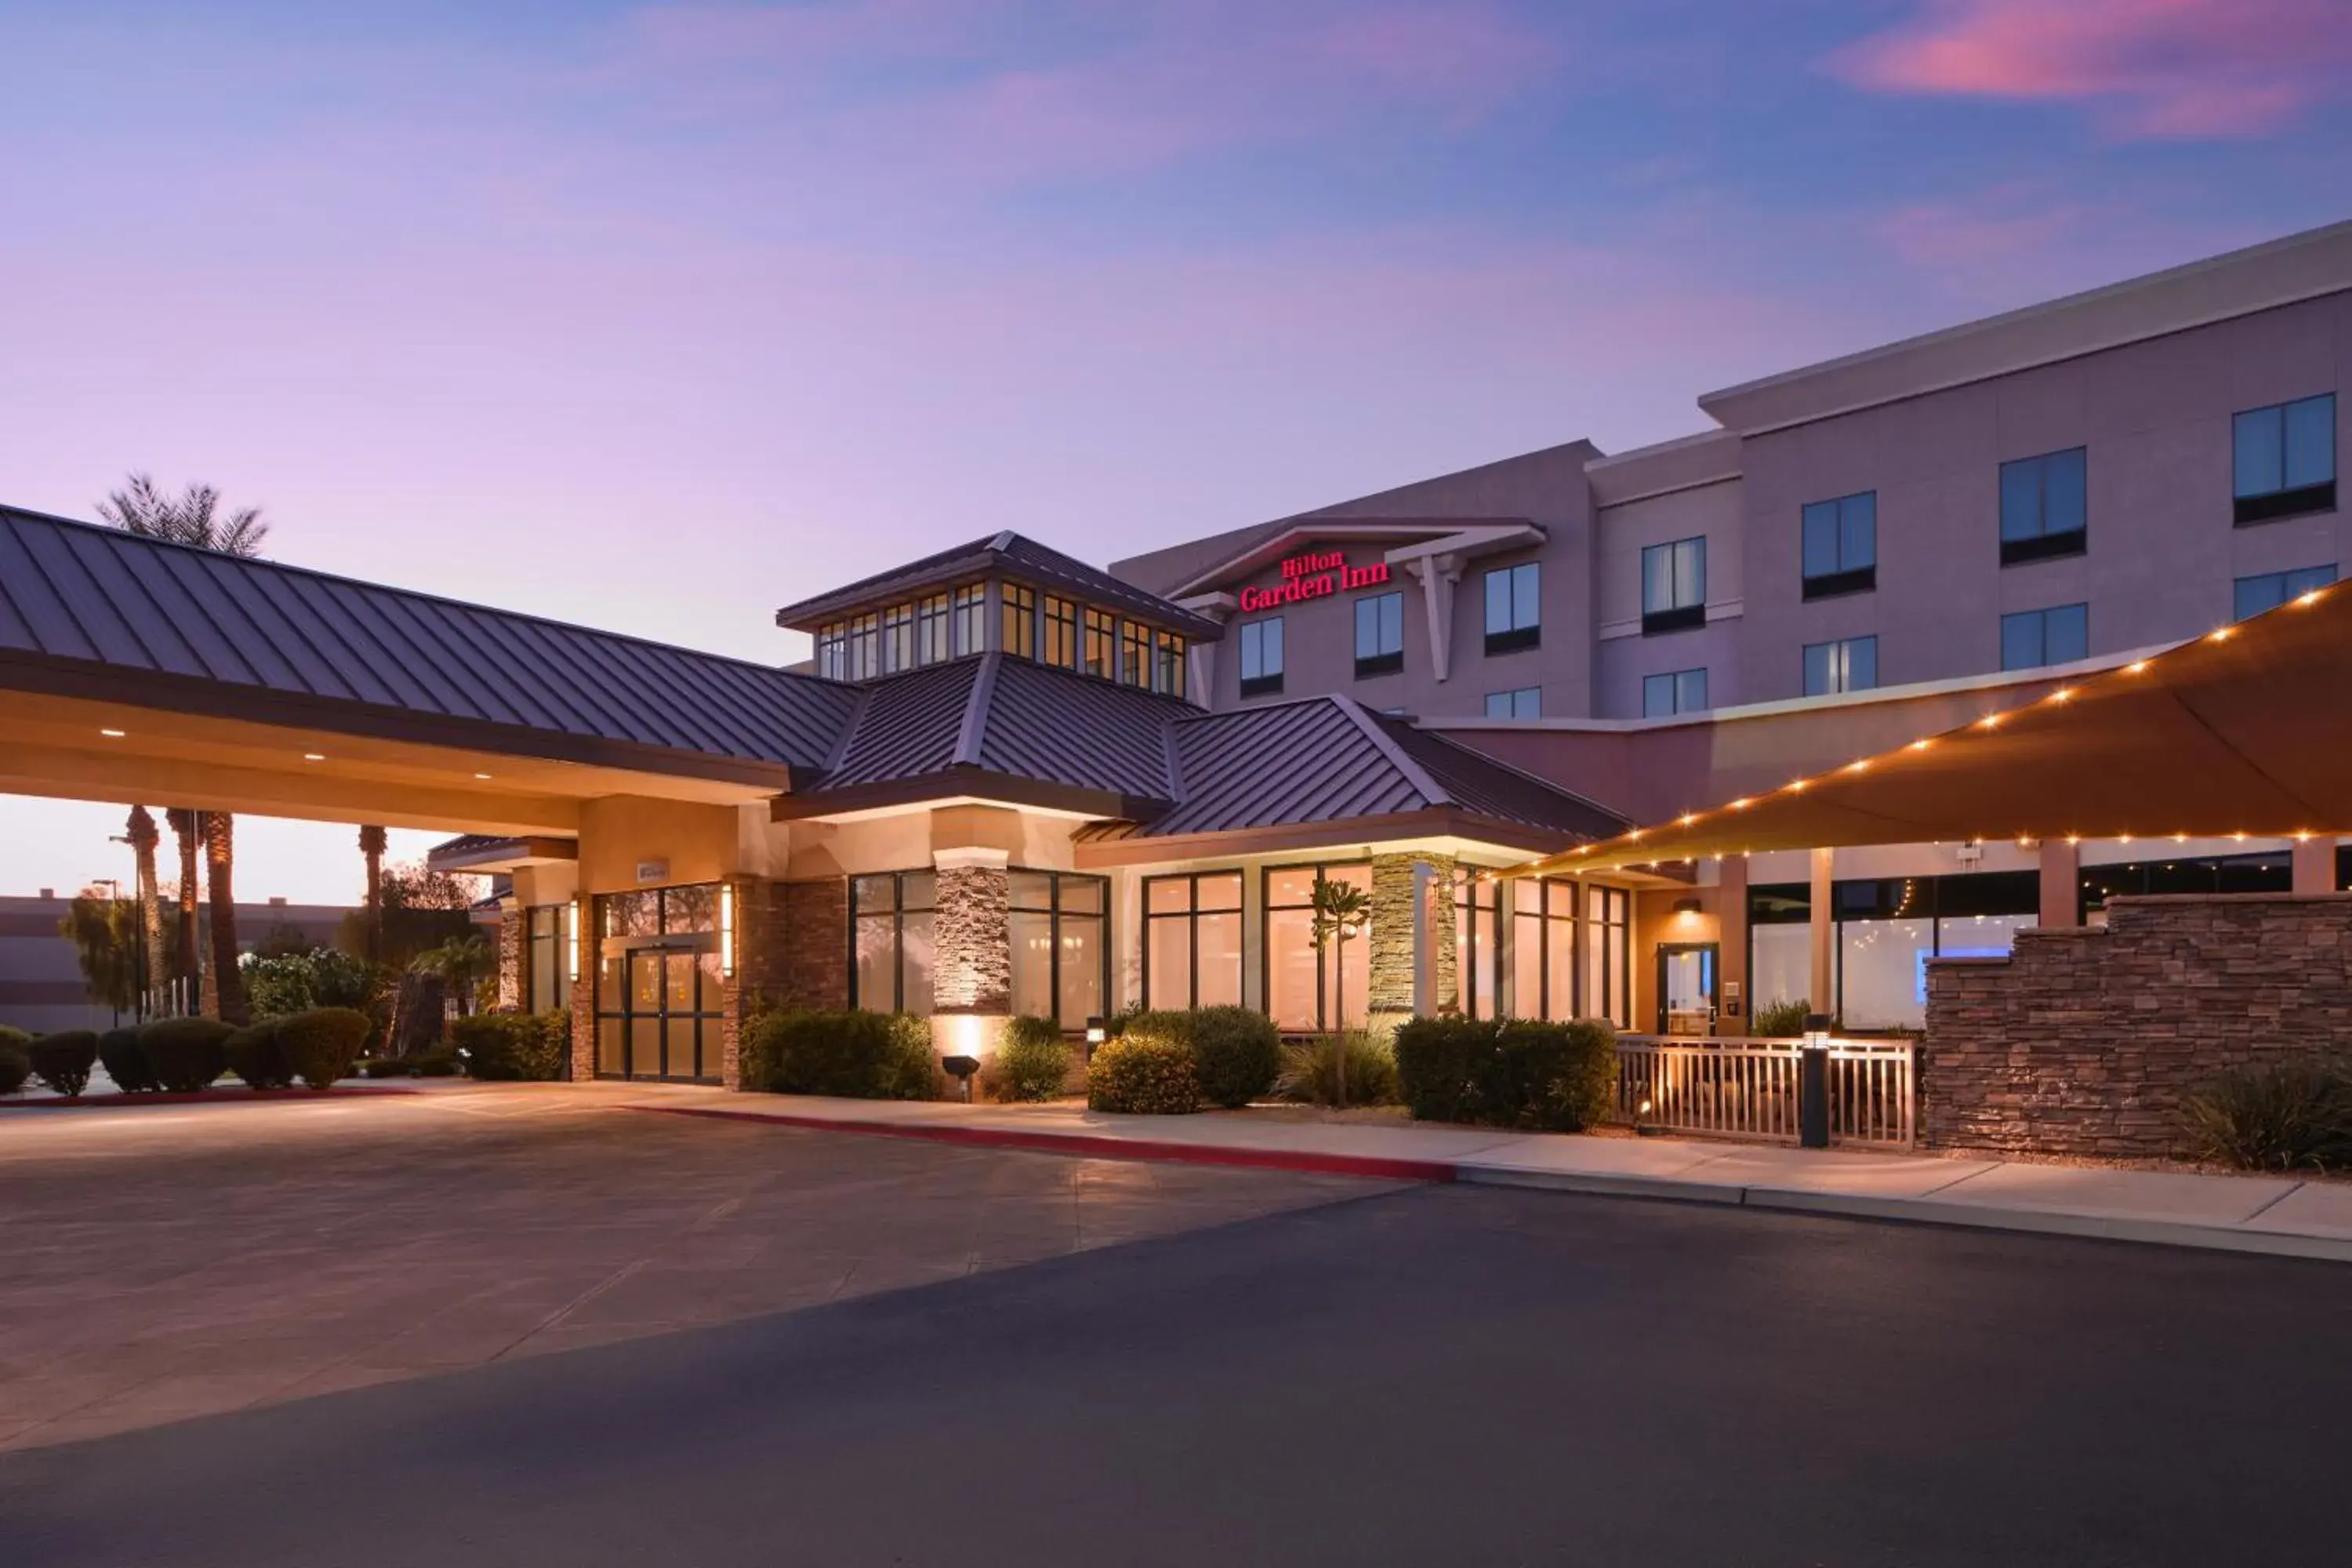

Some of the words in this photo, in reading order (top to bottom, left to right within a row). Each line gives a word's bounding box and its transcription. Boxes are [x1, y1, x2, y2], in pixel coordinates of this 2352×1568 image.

[1282, 551, 1343, 578] Hilton
[1240, 575, 1332, 612] Garden
[1341, 563, 1388, 590] Inn
